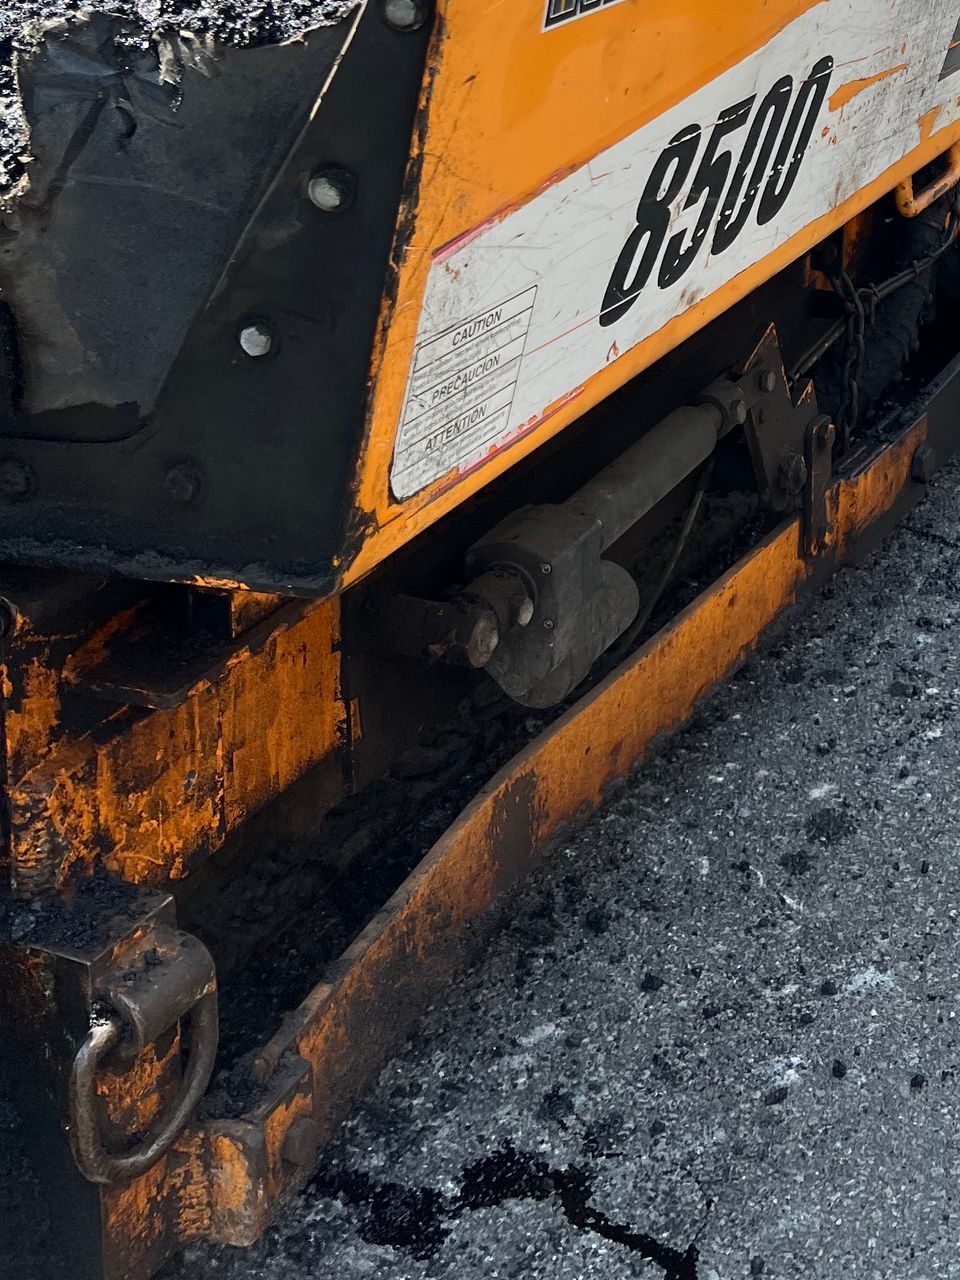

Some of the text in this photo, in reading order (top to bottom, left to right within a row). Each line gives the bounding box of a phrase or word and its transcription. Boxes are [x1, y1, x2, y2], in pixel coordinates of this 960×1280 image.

[599, 55, 834, 328] 8500
[452, 308, 503, 347] CAUTION
[425, 403, 488, 453] ATTENTION
